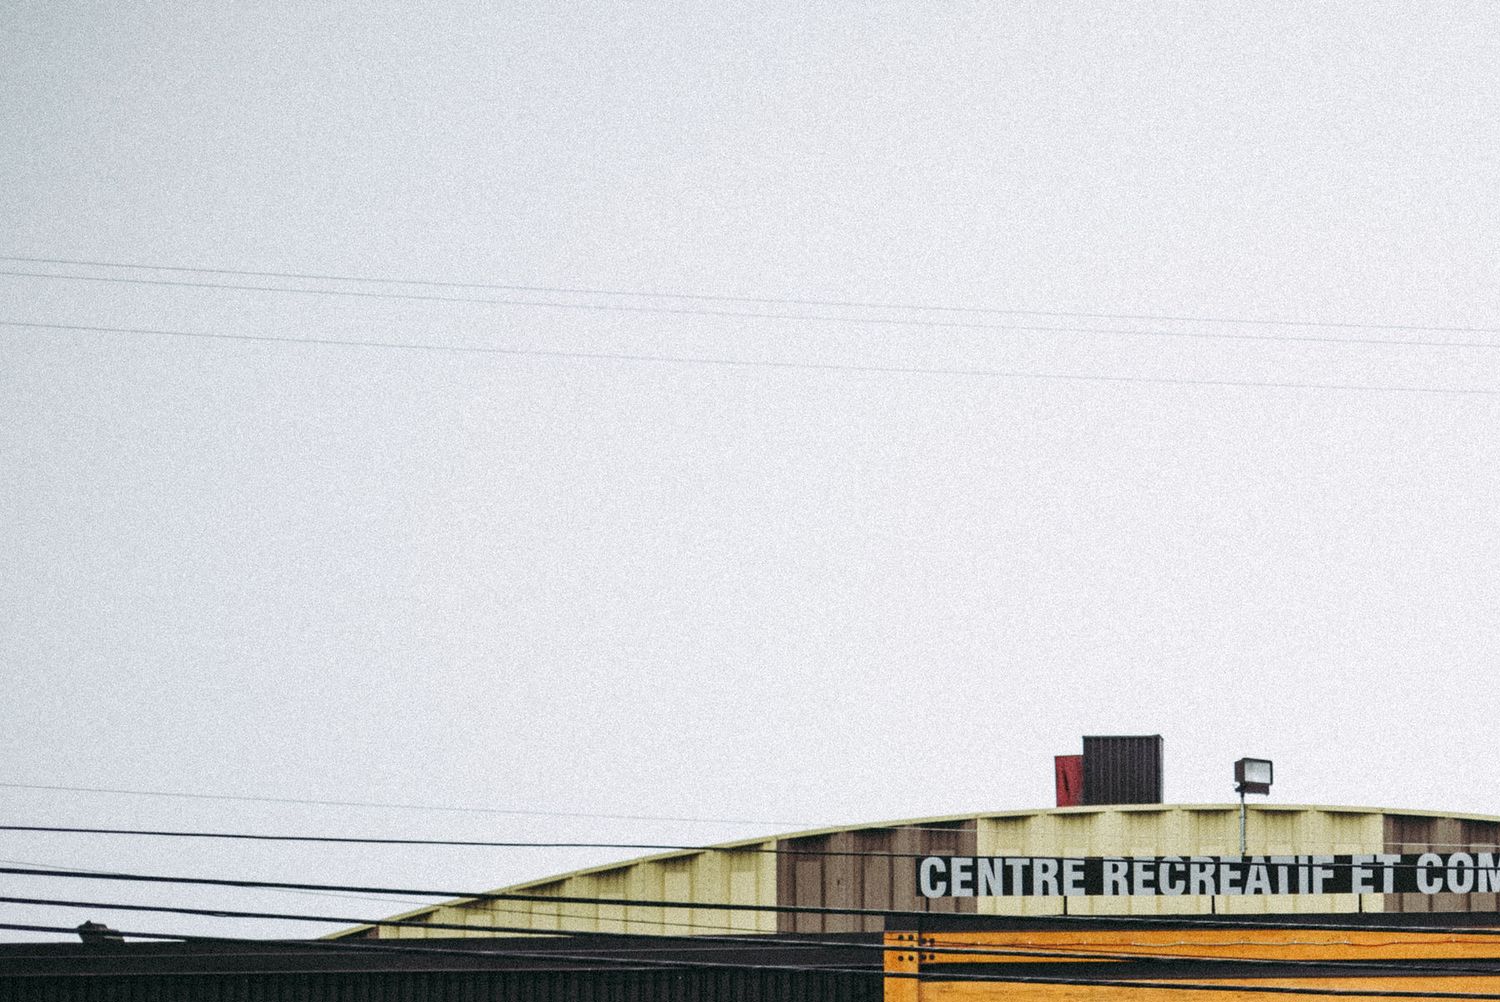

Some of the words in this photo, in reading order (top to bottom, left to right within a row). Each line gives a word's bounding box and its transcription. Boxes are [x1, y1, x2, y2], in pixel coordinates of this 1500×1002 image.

[920, 856, 1086, 898] CENTRE
[1103, 855, 1335, 896] RECREATIF
[1352, 854, 1400, 894] ET
